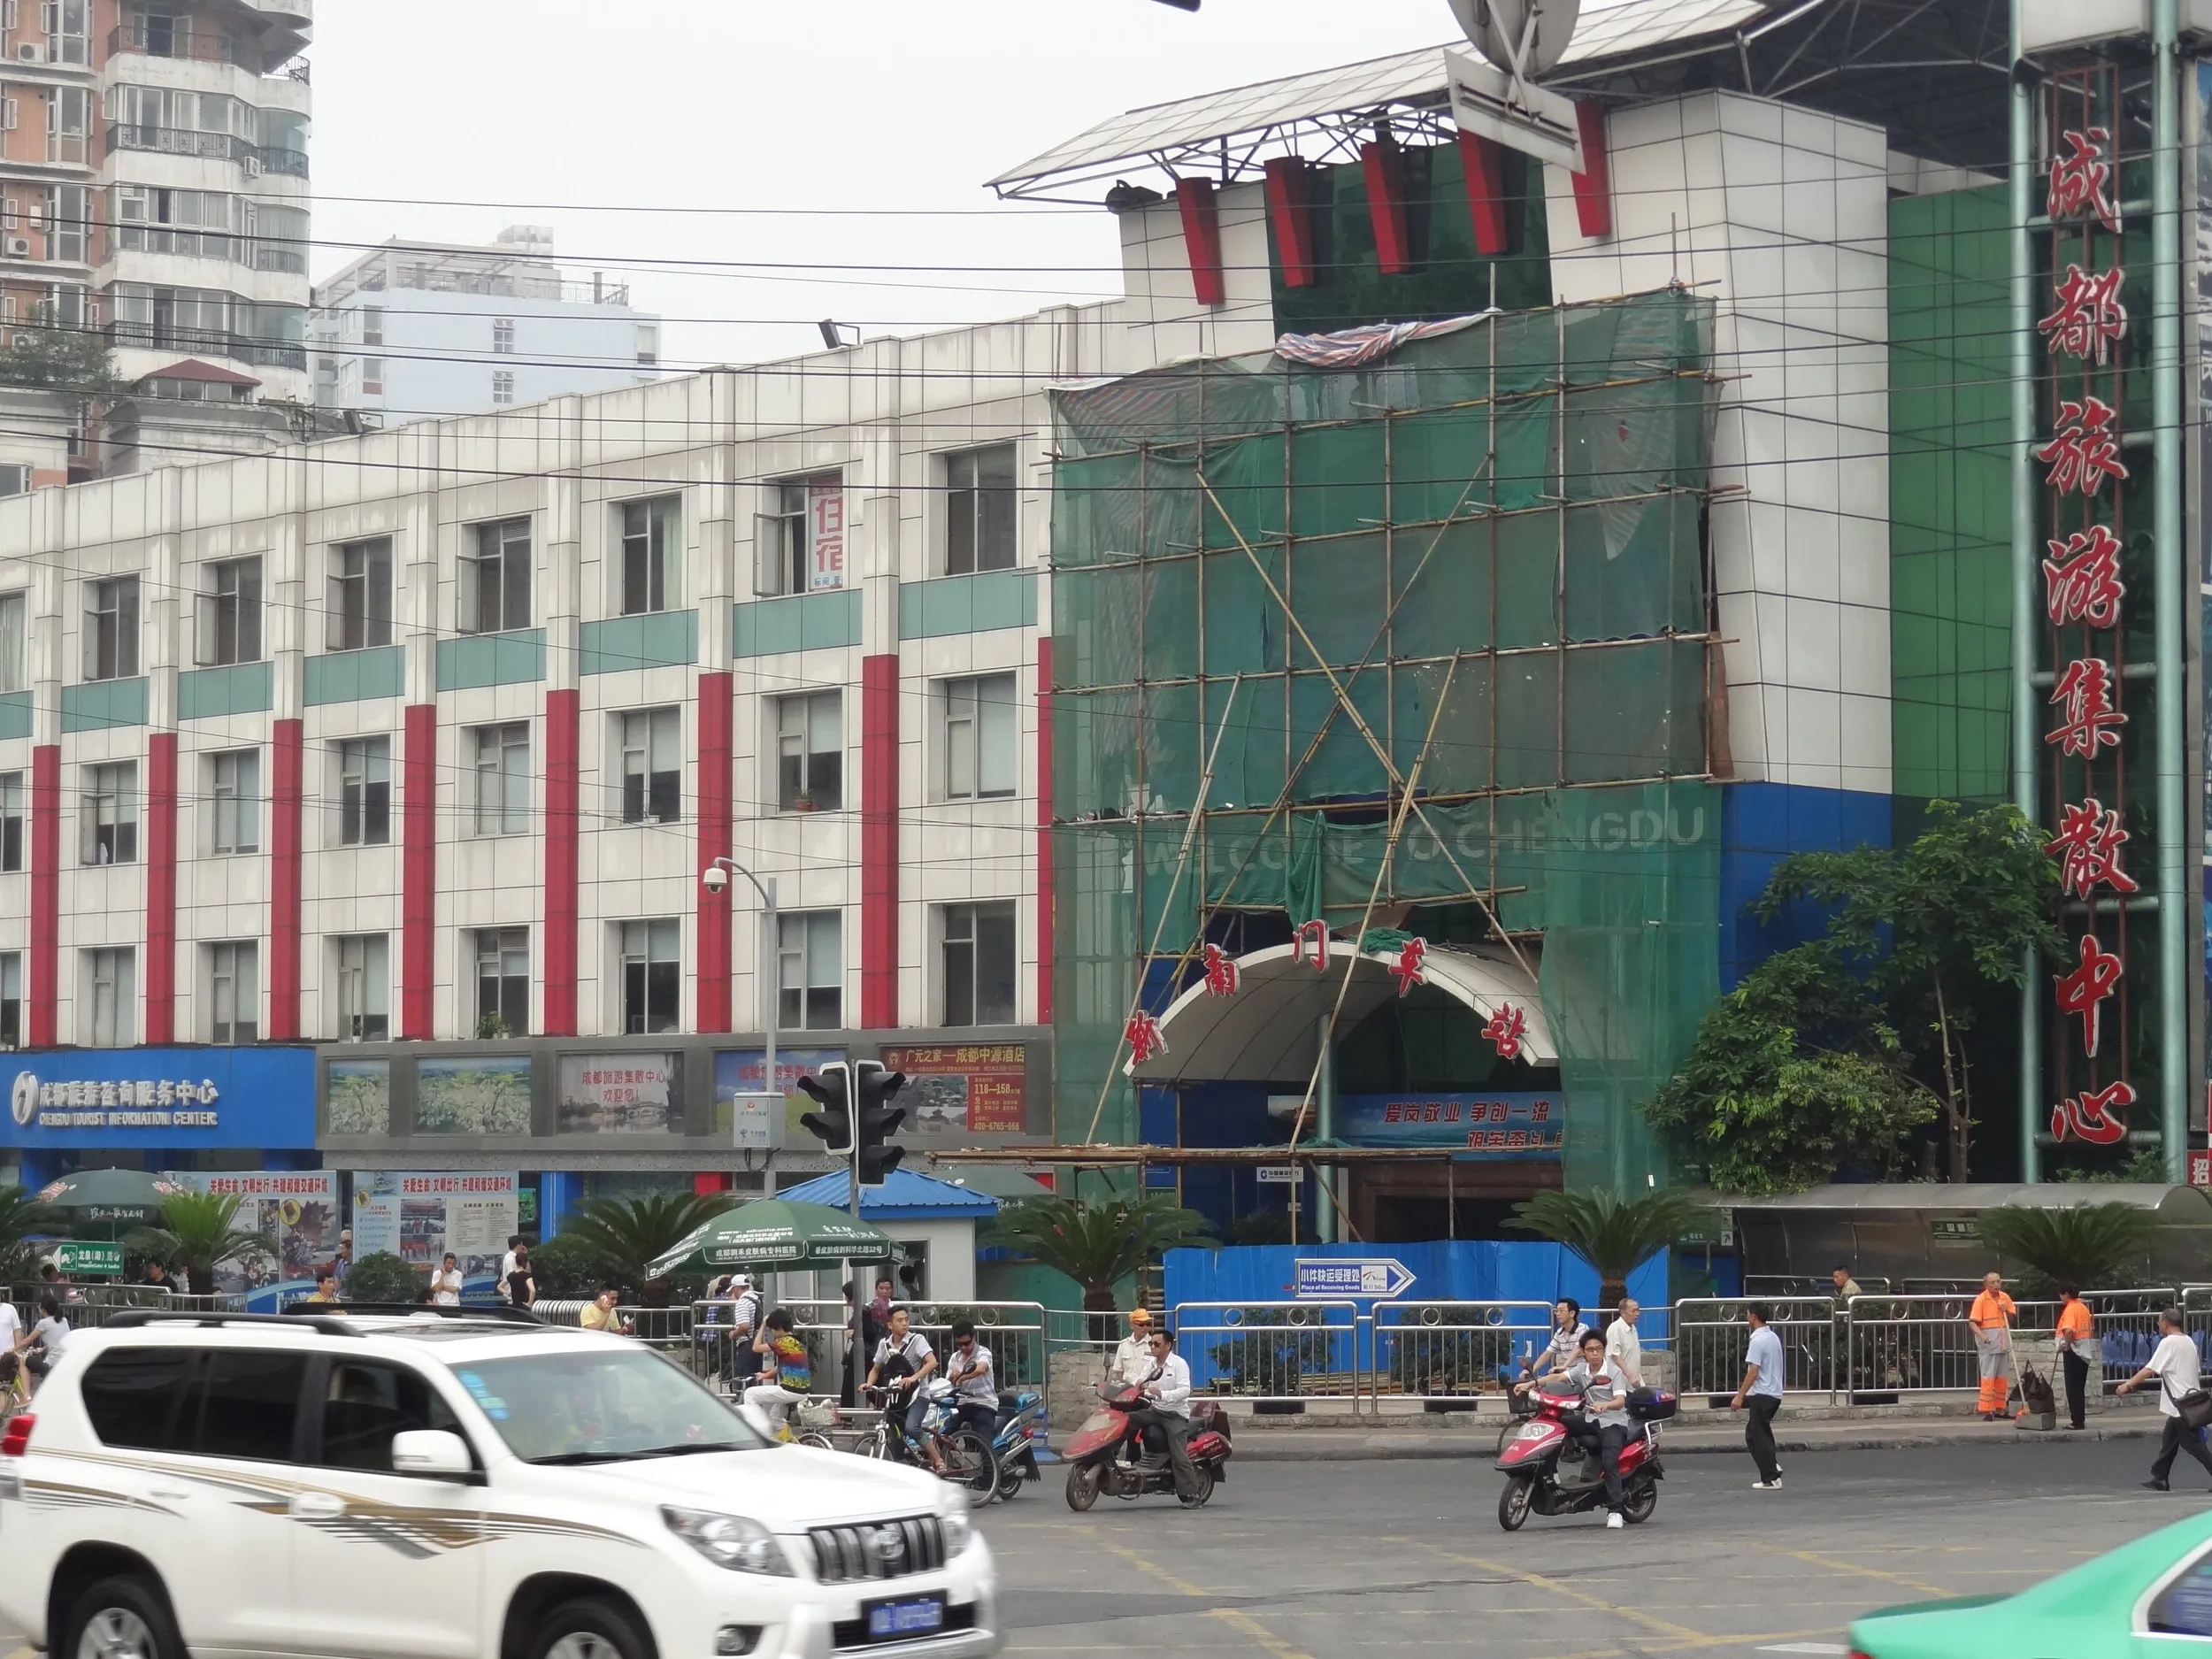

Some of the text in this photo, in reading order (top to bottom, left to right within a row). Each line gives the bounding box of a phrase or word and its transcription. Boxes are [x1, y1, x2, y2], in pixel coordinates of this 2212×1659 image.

[2037, 127, 2139, 1144] 成都旅游集散中心
[582, 1069, 666, 1085] 成都旅游集散中心
[39, 1110, 219, 1125] CHENGDU TOURIST INFORMATION CENTER
[1385, 1101, 1550, 1123] 爱岗敬业 争创一流
[211, 1178, 239, 1194] 关爱生命
[242, 1178, 269, 1194] 文明出行
[403, 1178, 431, 1193] 关爱生命
[433, 1178, 459, 1193] 文明出行
[1301, 1268, 1361, 1282] 小件快运受理处
